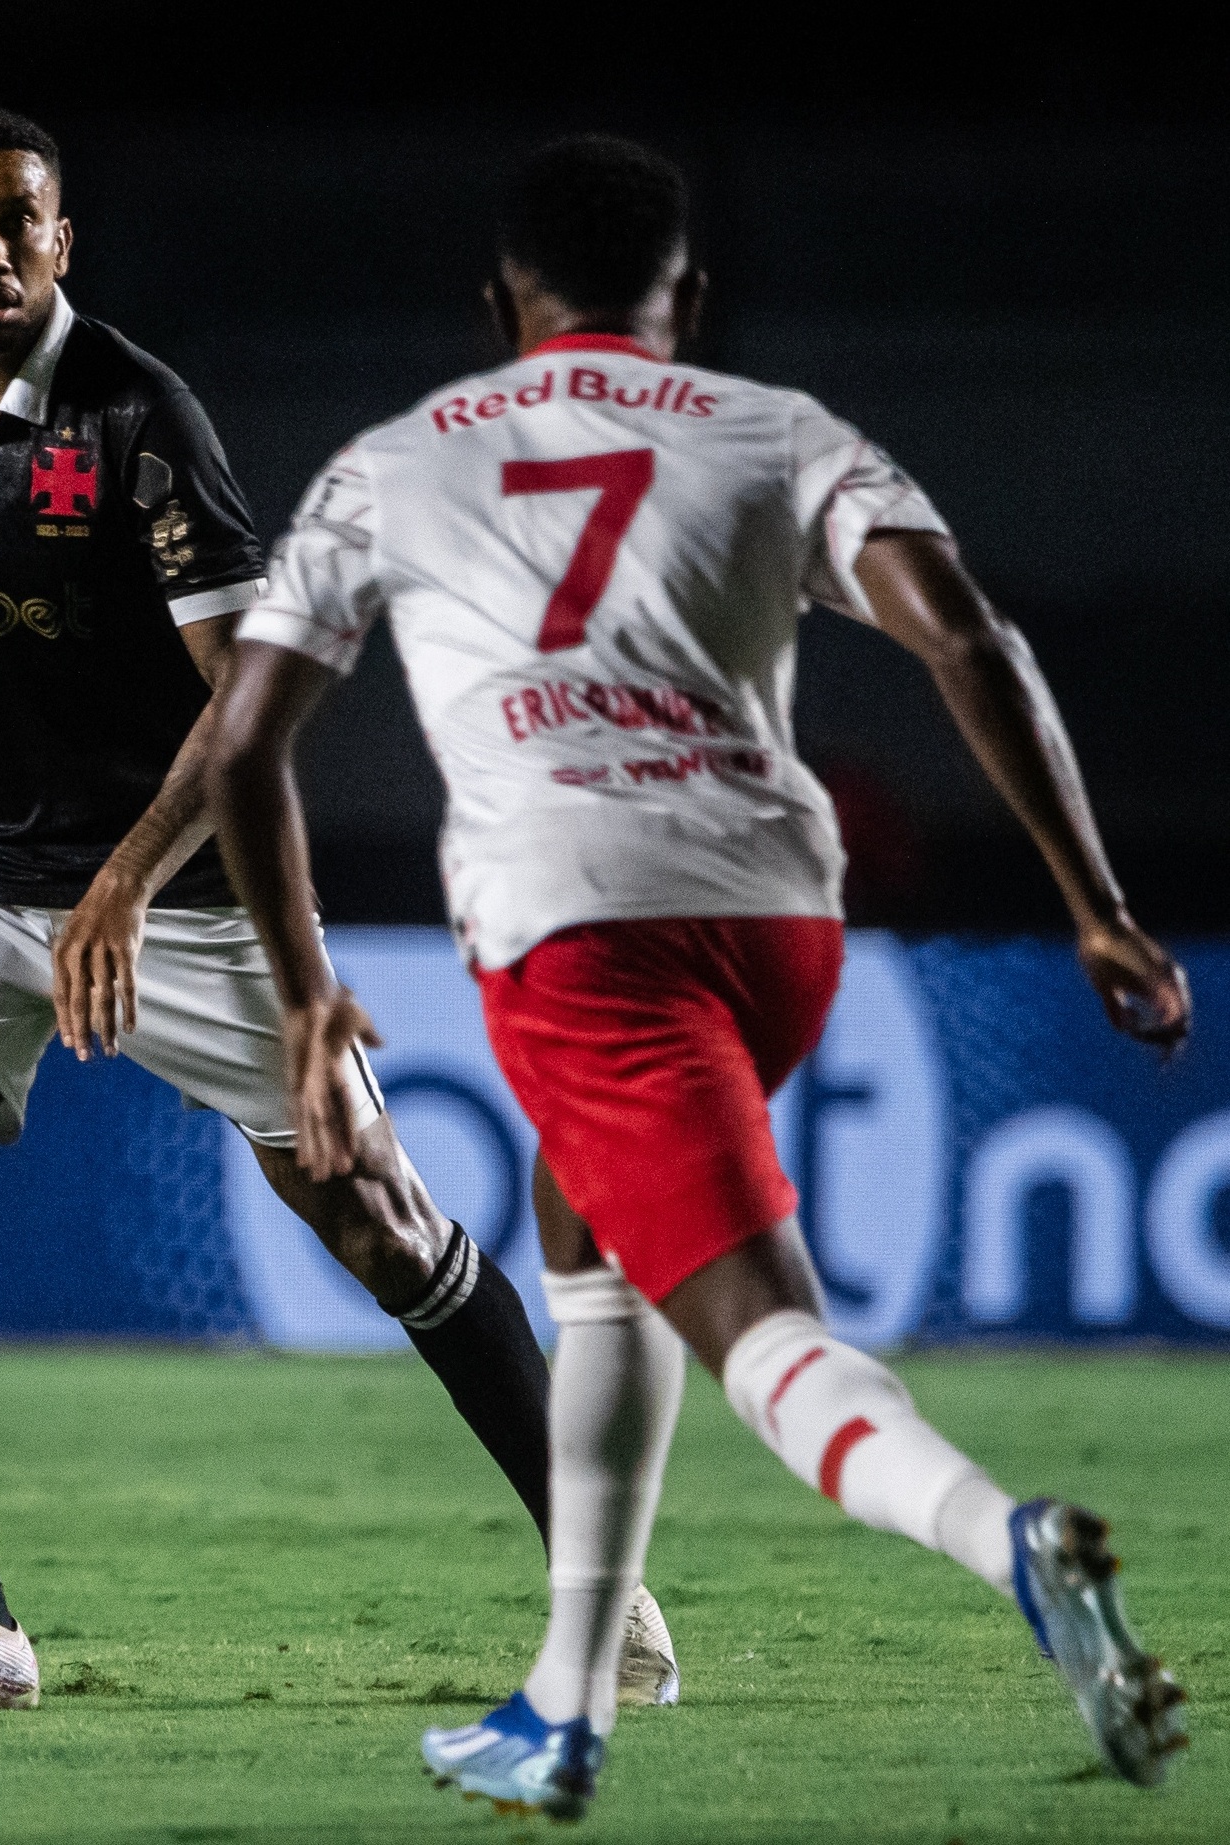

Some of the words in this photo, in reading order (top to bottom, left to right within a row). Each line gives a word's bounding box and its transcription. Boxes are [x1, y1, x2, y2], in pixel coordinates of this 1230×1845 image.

[431, 370, 555, 434] Red
[567, 367, 720, 419] Bulls
[501, 448, 655, 653] 7
